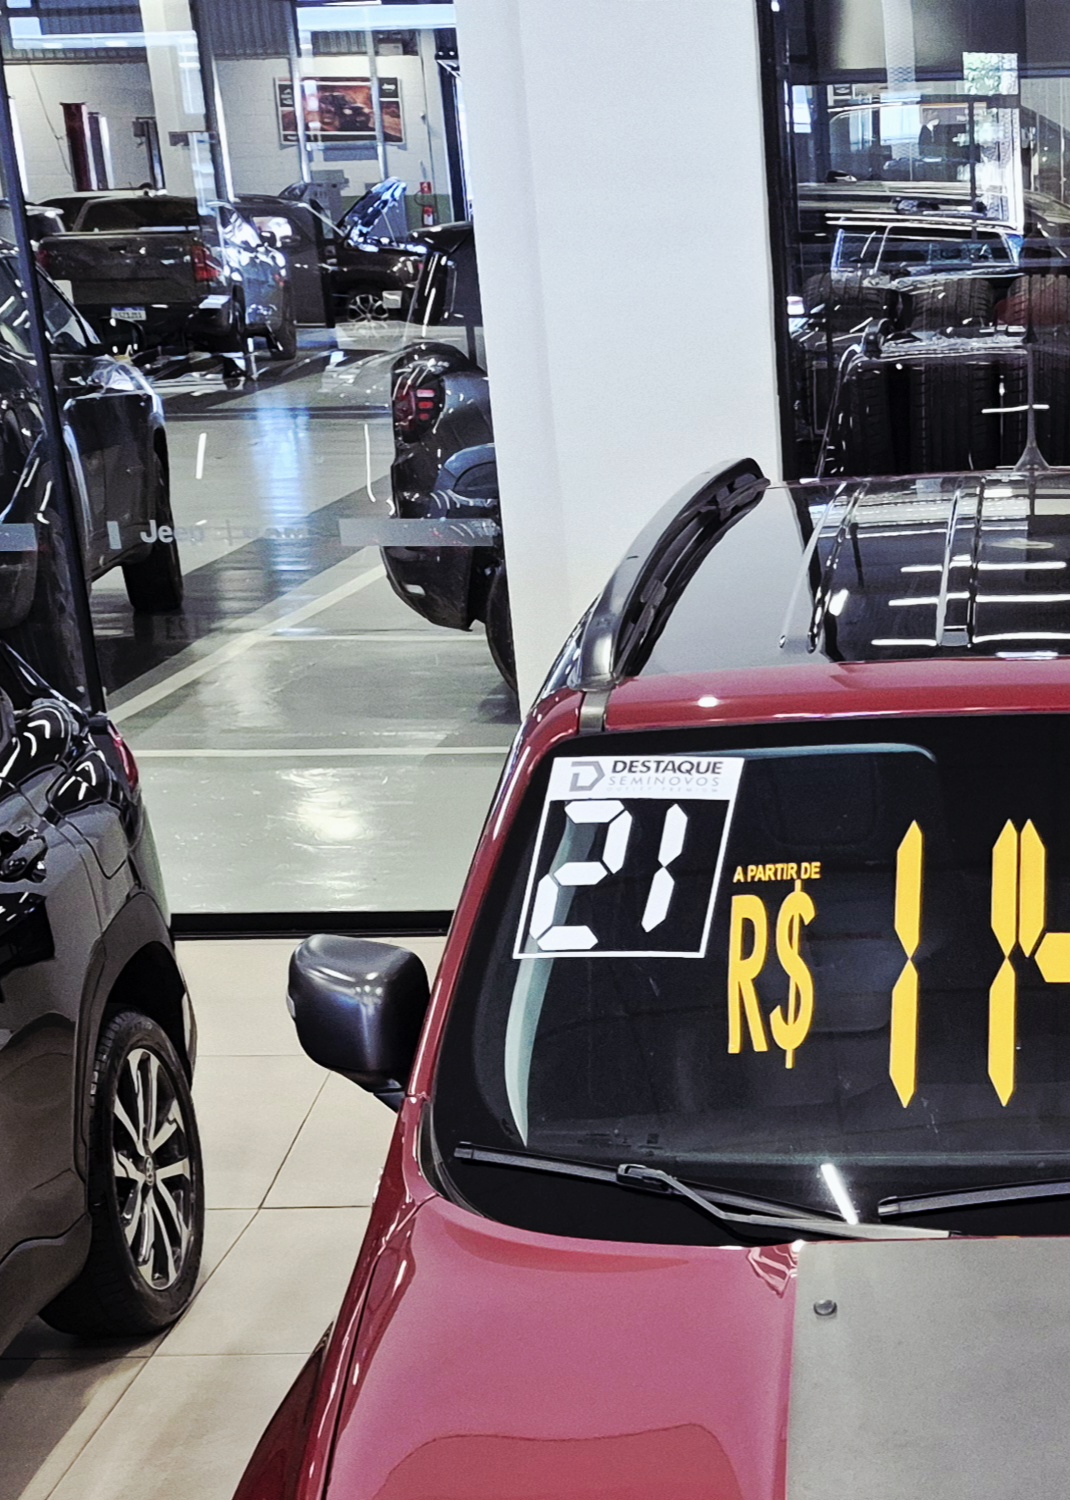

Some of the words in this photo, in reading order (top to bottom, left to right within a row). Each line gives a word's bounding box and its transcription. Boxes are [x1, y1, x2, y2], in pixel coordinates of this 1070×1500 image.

[611, 759, 724, 775] DESTAQUE
[608, 775, 720, 788] SEMINOVOS
[530, 800, 688, 951] 21
[732, 865, 745, 883] A
[747, 862, 798, 882] PARTIR
[800, 861, 821, 880] DE
[726, 879, 817, 1069] R$
